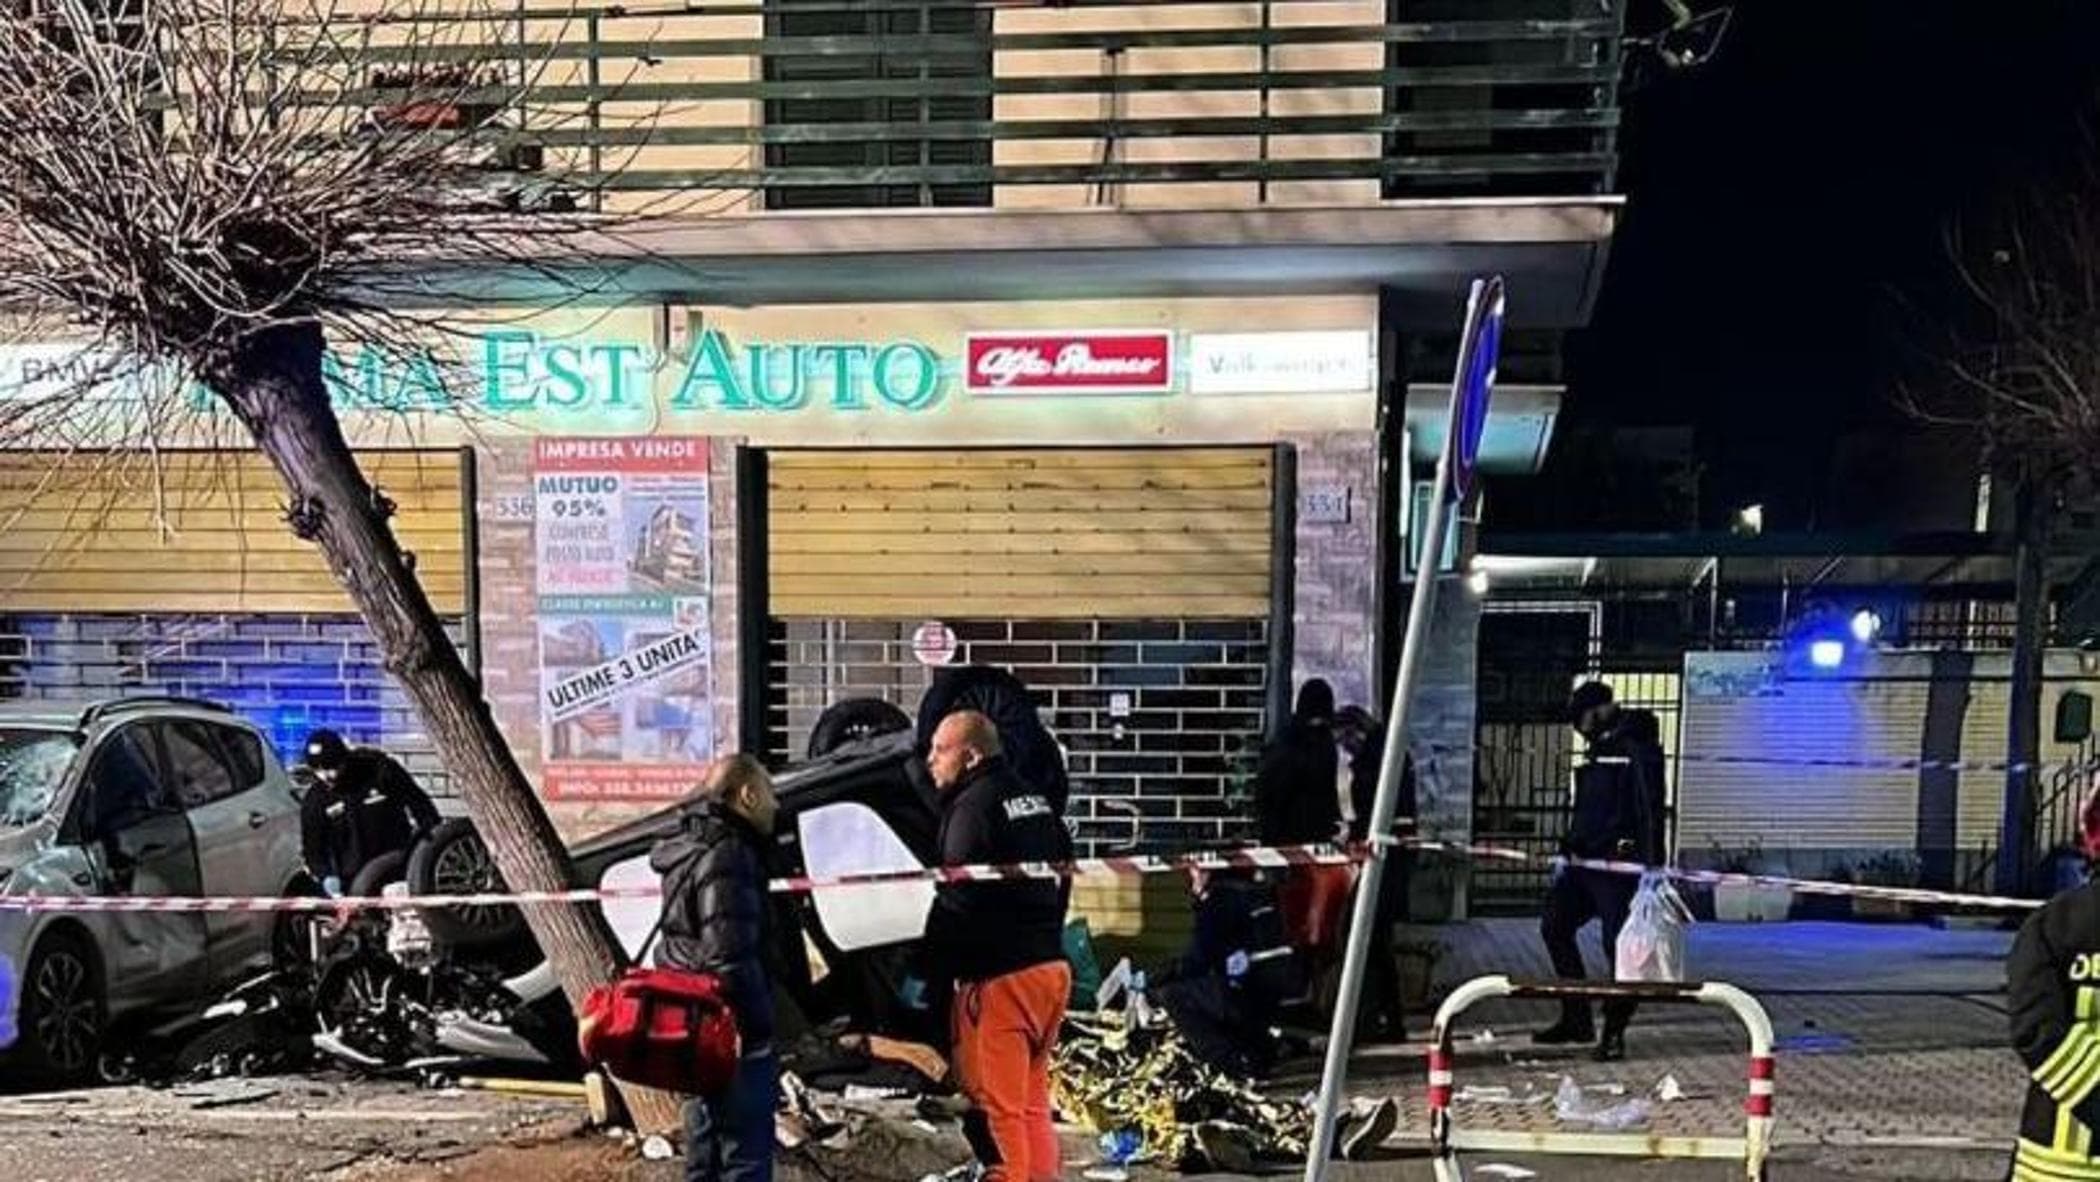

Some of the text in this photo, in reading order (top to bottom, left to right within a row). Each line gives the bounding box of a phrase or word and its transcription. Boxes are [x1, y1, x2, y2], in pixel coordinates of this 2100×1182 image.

[539, 440, 696, 458] IMPRESA VENDE
[539, 477, 618, 494] MUTUO
[552, 500, 606, 517] 95%
[547, 665, 617, 709] ULTIME
[619, 659, 635, 680] 3
